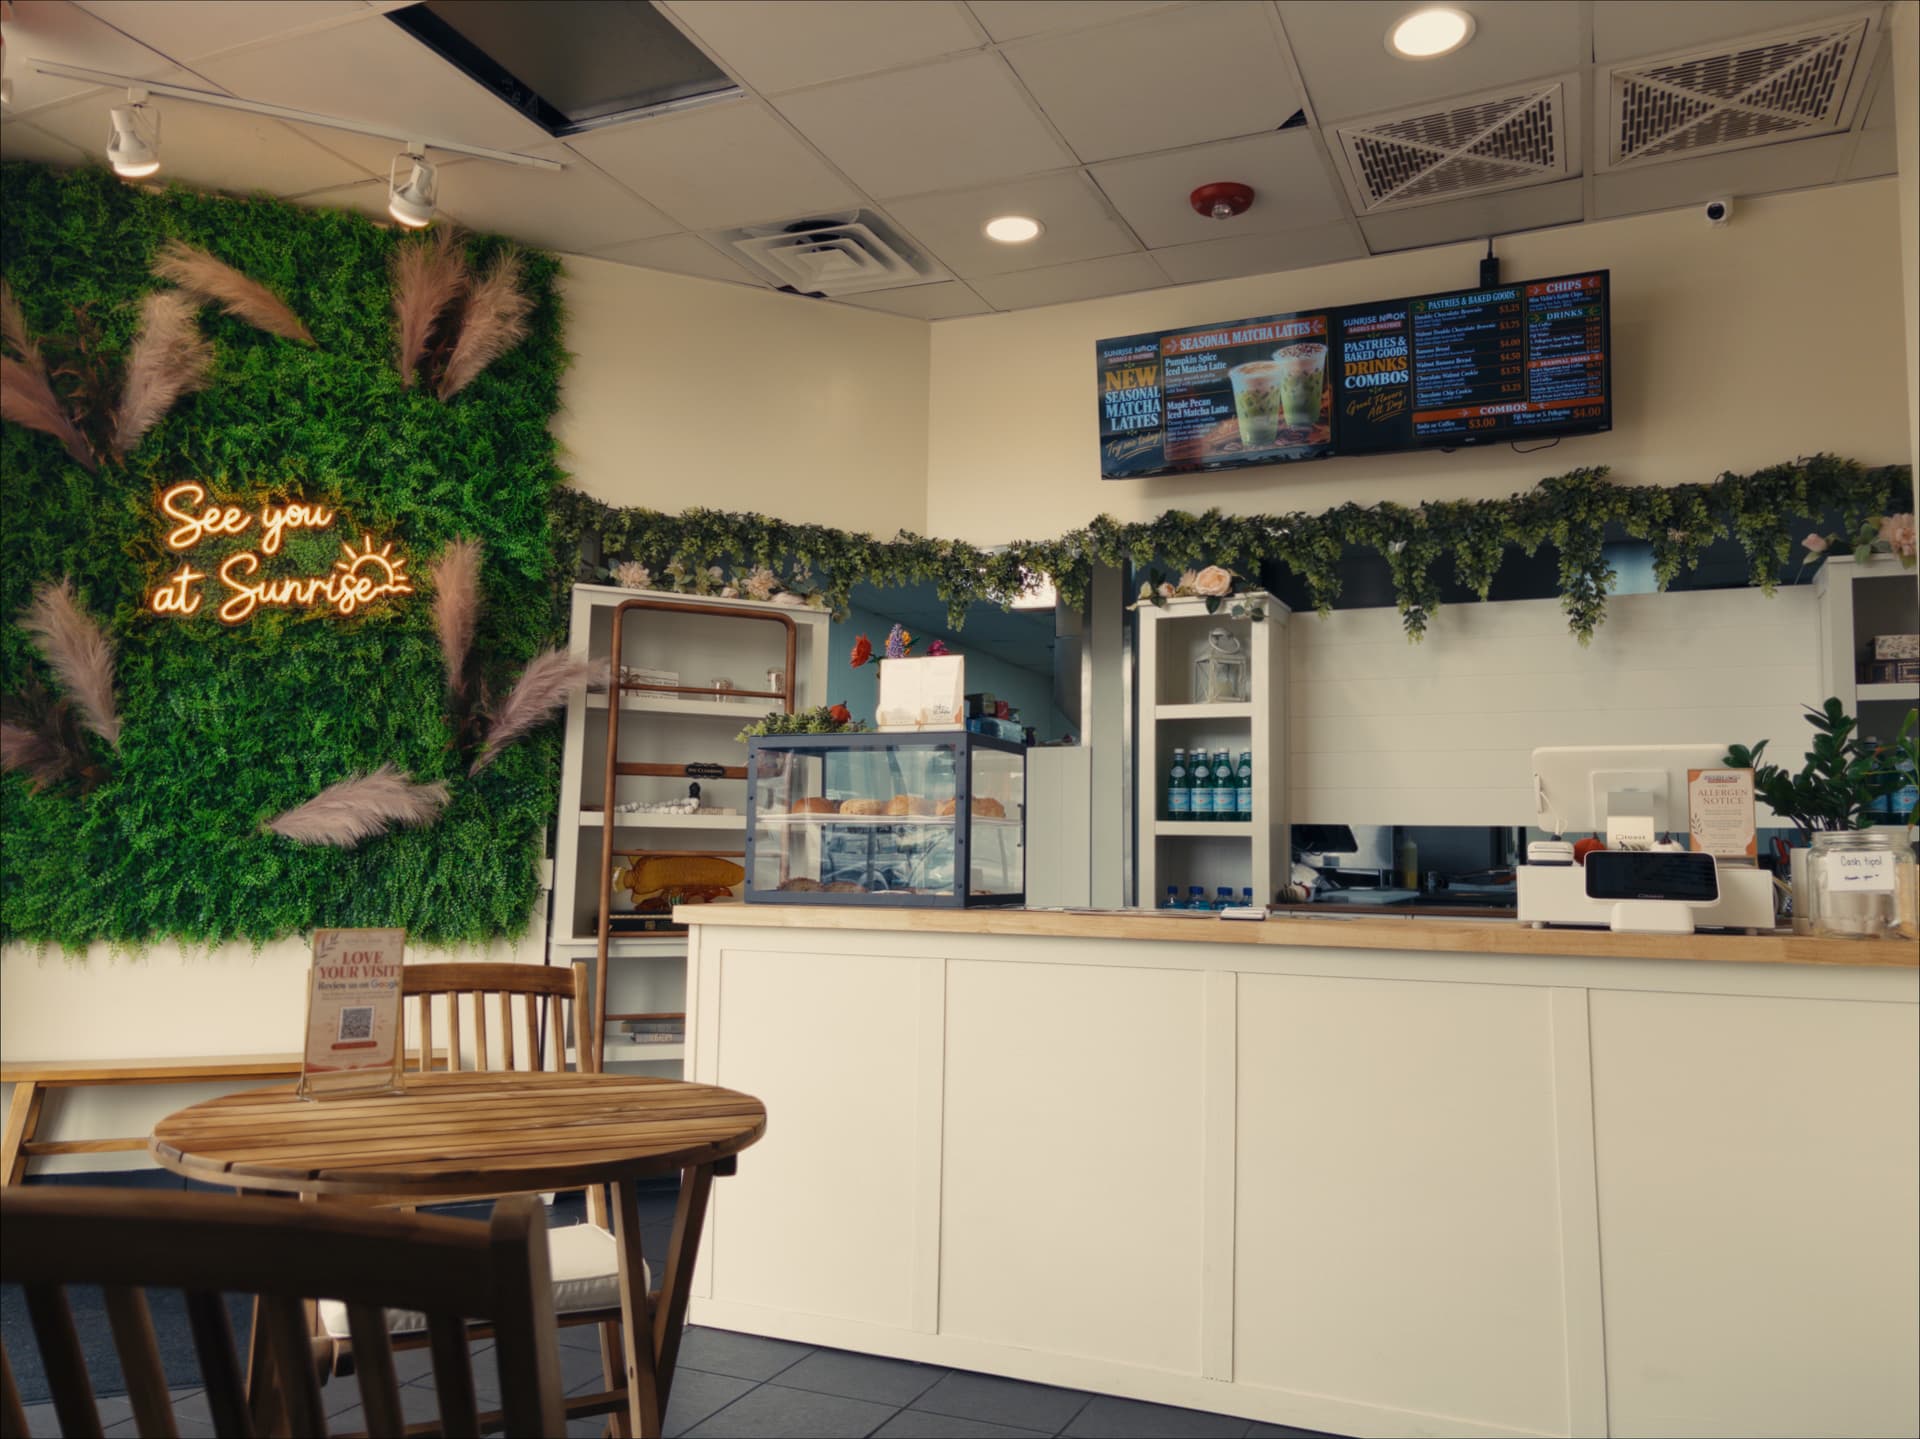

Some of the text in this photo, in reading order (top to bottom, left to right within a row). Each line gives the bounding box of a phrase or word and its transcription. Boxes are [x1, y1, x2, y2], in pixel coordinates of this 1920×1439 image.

[1546, 280, 1582, 294] CHIPS
[1428, 289, 1516, 310] PASTRIES & BAKED GOODS
[1343, 315, 1377, 327] SUNRISE
[1546, 308, 1584, 320] DRINKS
[1180, 321, 1311, 351] SEASONAL MATCHA LATTES
[1344, 336, 1396, 352] PASTRIES
[1398, 336, 1406, 346] &
[1165, 355, 1197, 367] Pumpkin
[1198, 352, 1217, 364] Spice
[1344, 350, 1375, 362] BAKED
[1376, 345, 1408, 358] GOODS
[1165, 361, 1227, 376] Iced Matcha Latte
[1344, 356, 1407, 376] DRINKS
[1104, 364, 1158, 391] NEW
[1344, 370, 1409, 389] COMBOS
[1105, 386, 1161, 404] SEASONAL
[1105, 399, 1161, 418] MATCHA
[1167, 398, 1211, 410] Maple Pecan
[1479, 403, 1528, 416] COMBOS
[1167, 405, 1229, 419] Iced Matcha Latte
[1572, 407, 1601, 419] $4.00
[1111, 413, 1159, 432] LATTES
[1468, 417, 1496, 430] $3.00
[163, 484, 333, 555] See you
[153, 552, 378, 623] at Sunrise
[1697, 788, 1748, 797] ALLERGEN
[1703, 796, 1744, 805] NOTICE
[1840, 855, 1861, 866] Cash
[342, 951, 384, 965] LOVE
[319, 966, 359, 979] YOUR
[318, 981, 346, 992] Review
